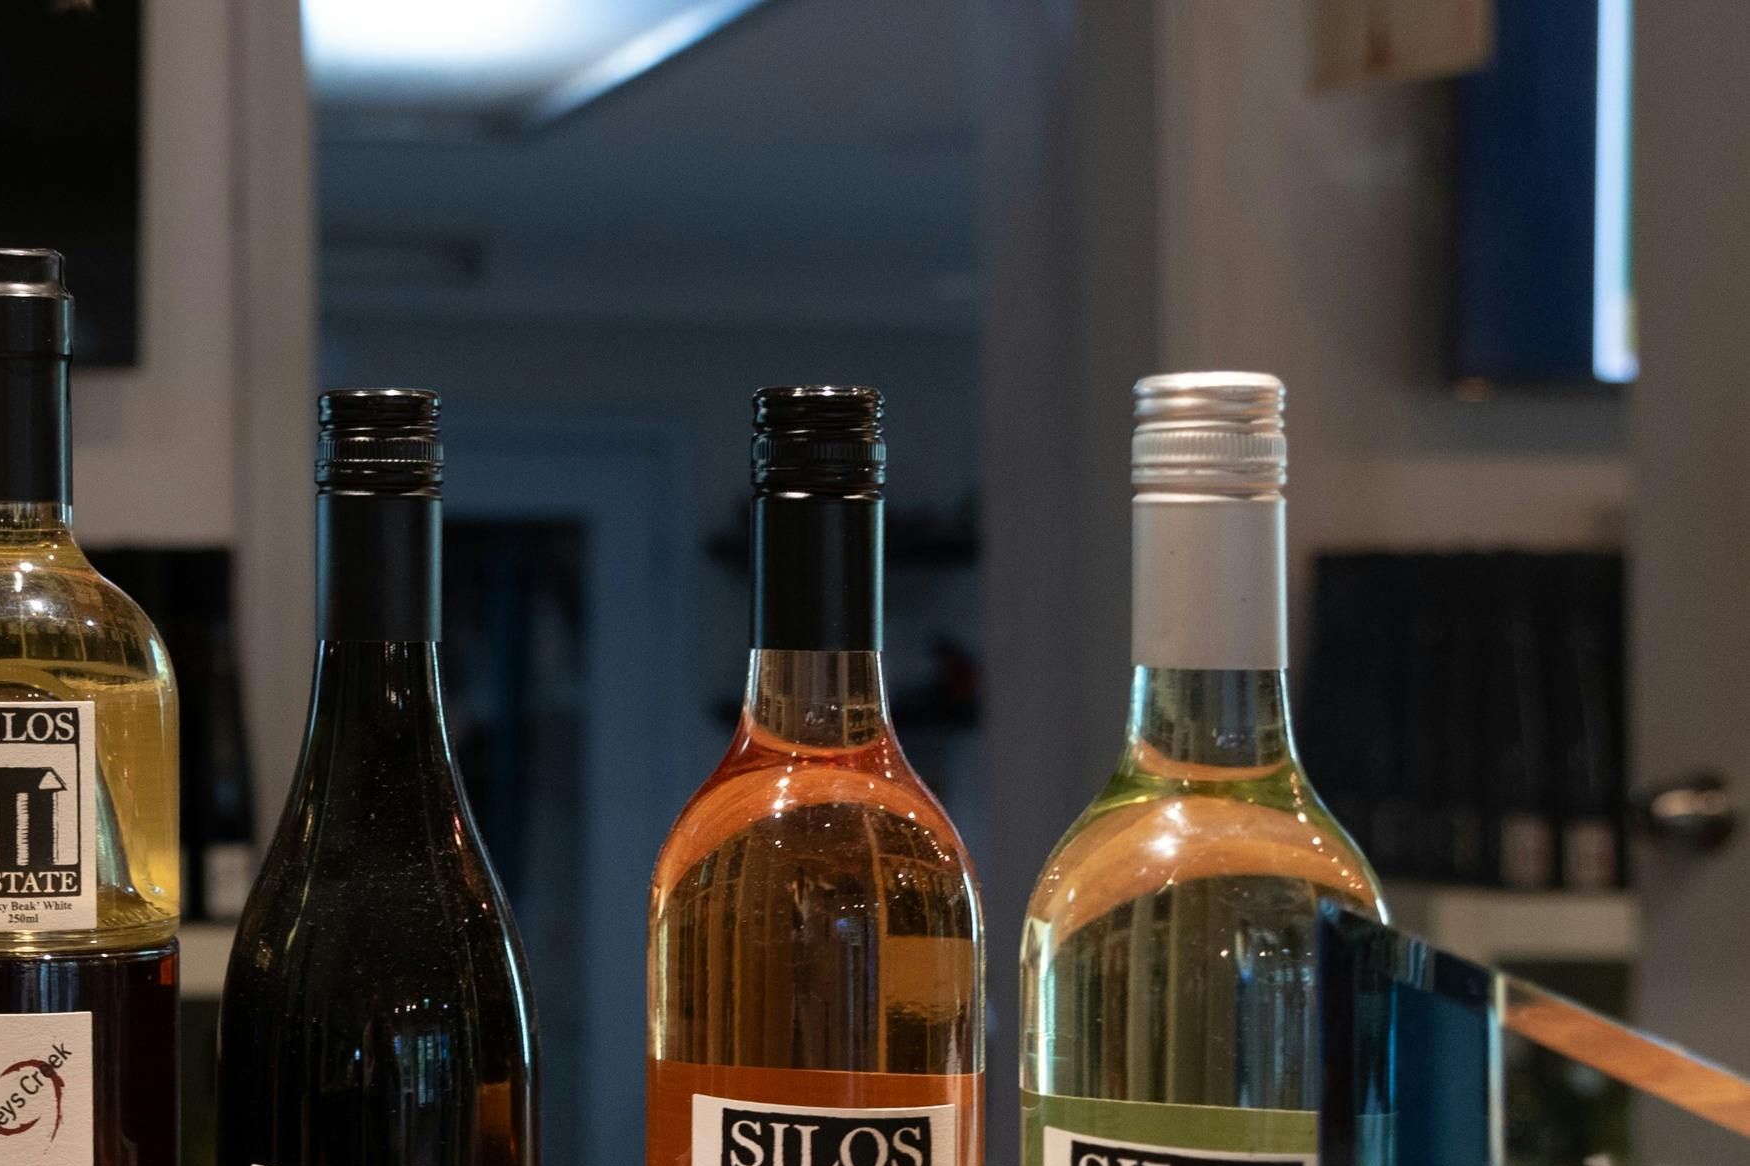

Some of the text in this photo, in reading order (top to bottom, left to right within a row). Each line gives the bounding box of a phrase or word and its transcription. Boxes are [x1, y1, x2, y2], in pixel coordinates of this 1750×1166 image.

[43, 901, 73, 911] White
[7, 913, 39, 923] 250ml
[19, 1042, 73, 1095] Creek
